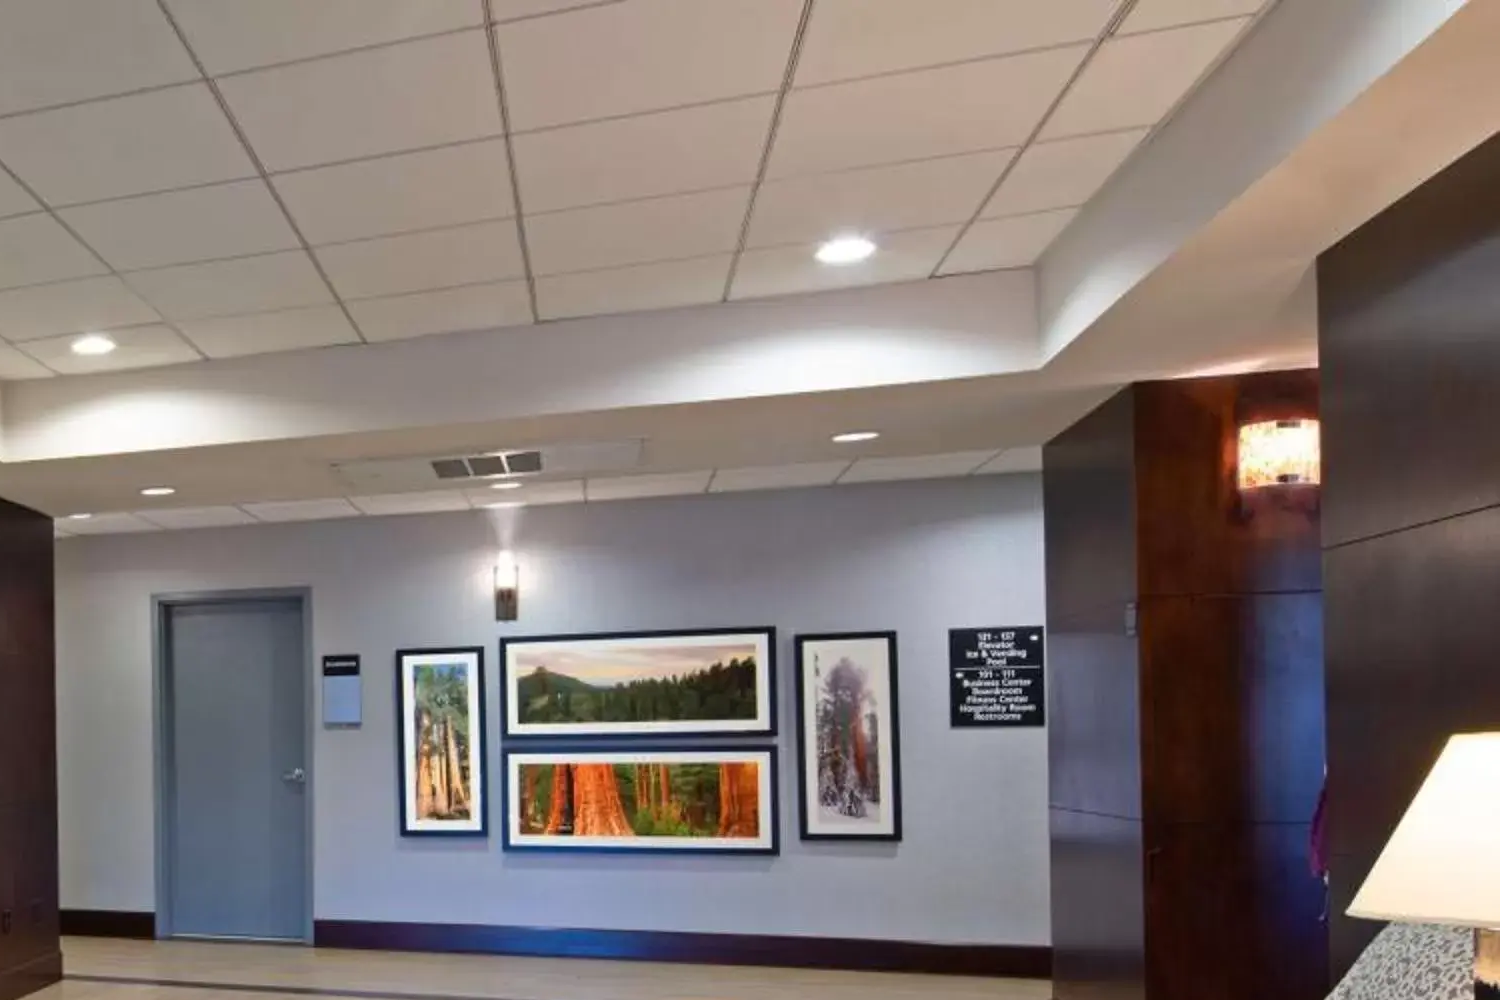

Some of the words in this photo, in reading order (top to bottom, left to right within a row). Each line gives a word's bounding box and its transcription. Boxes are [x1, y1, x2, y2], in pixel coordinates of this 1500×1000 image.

[978, 641, 1015, 649] Elevator
[989, 649, 1027, 659] Vending
[963, 679, 999, 688] Business
[971, 687, 1022, 695] Boardroom
[959, 704, 1007, 713] Hospitality
[973, 713, 1022, 721] Restrooms
